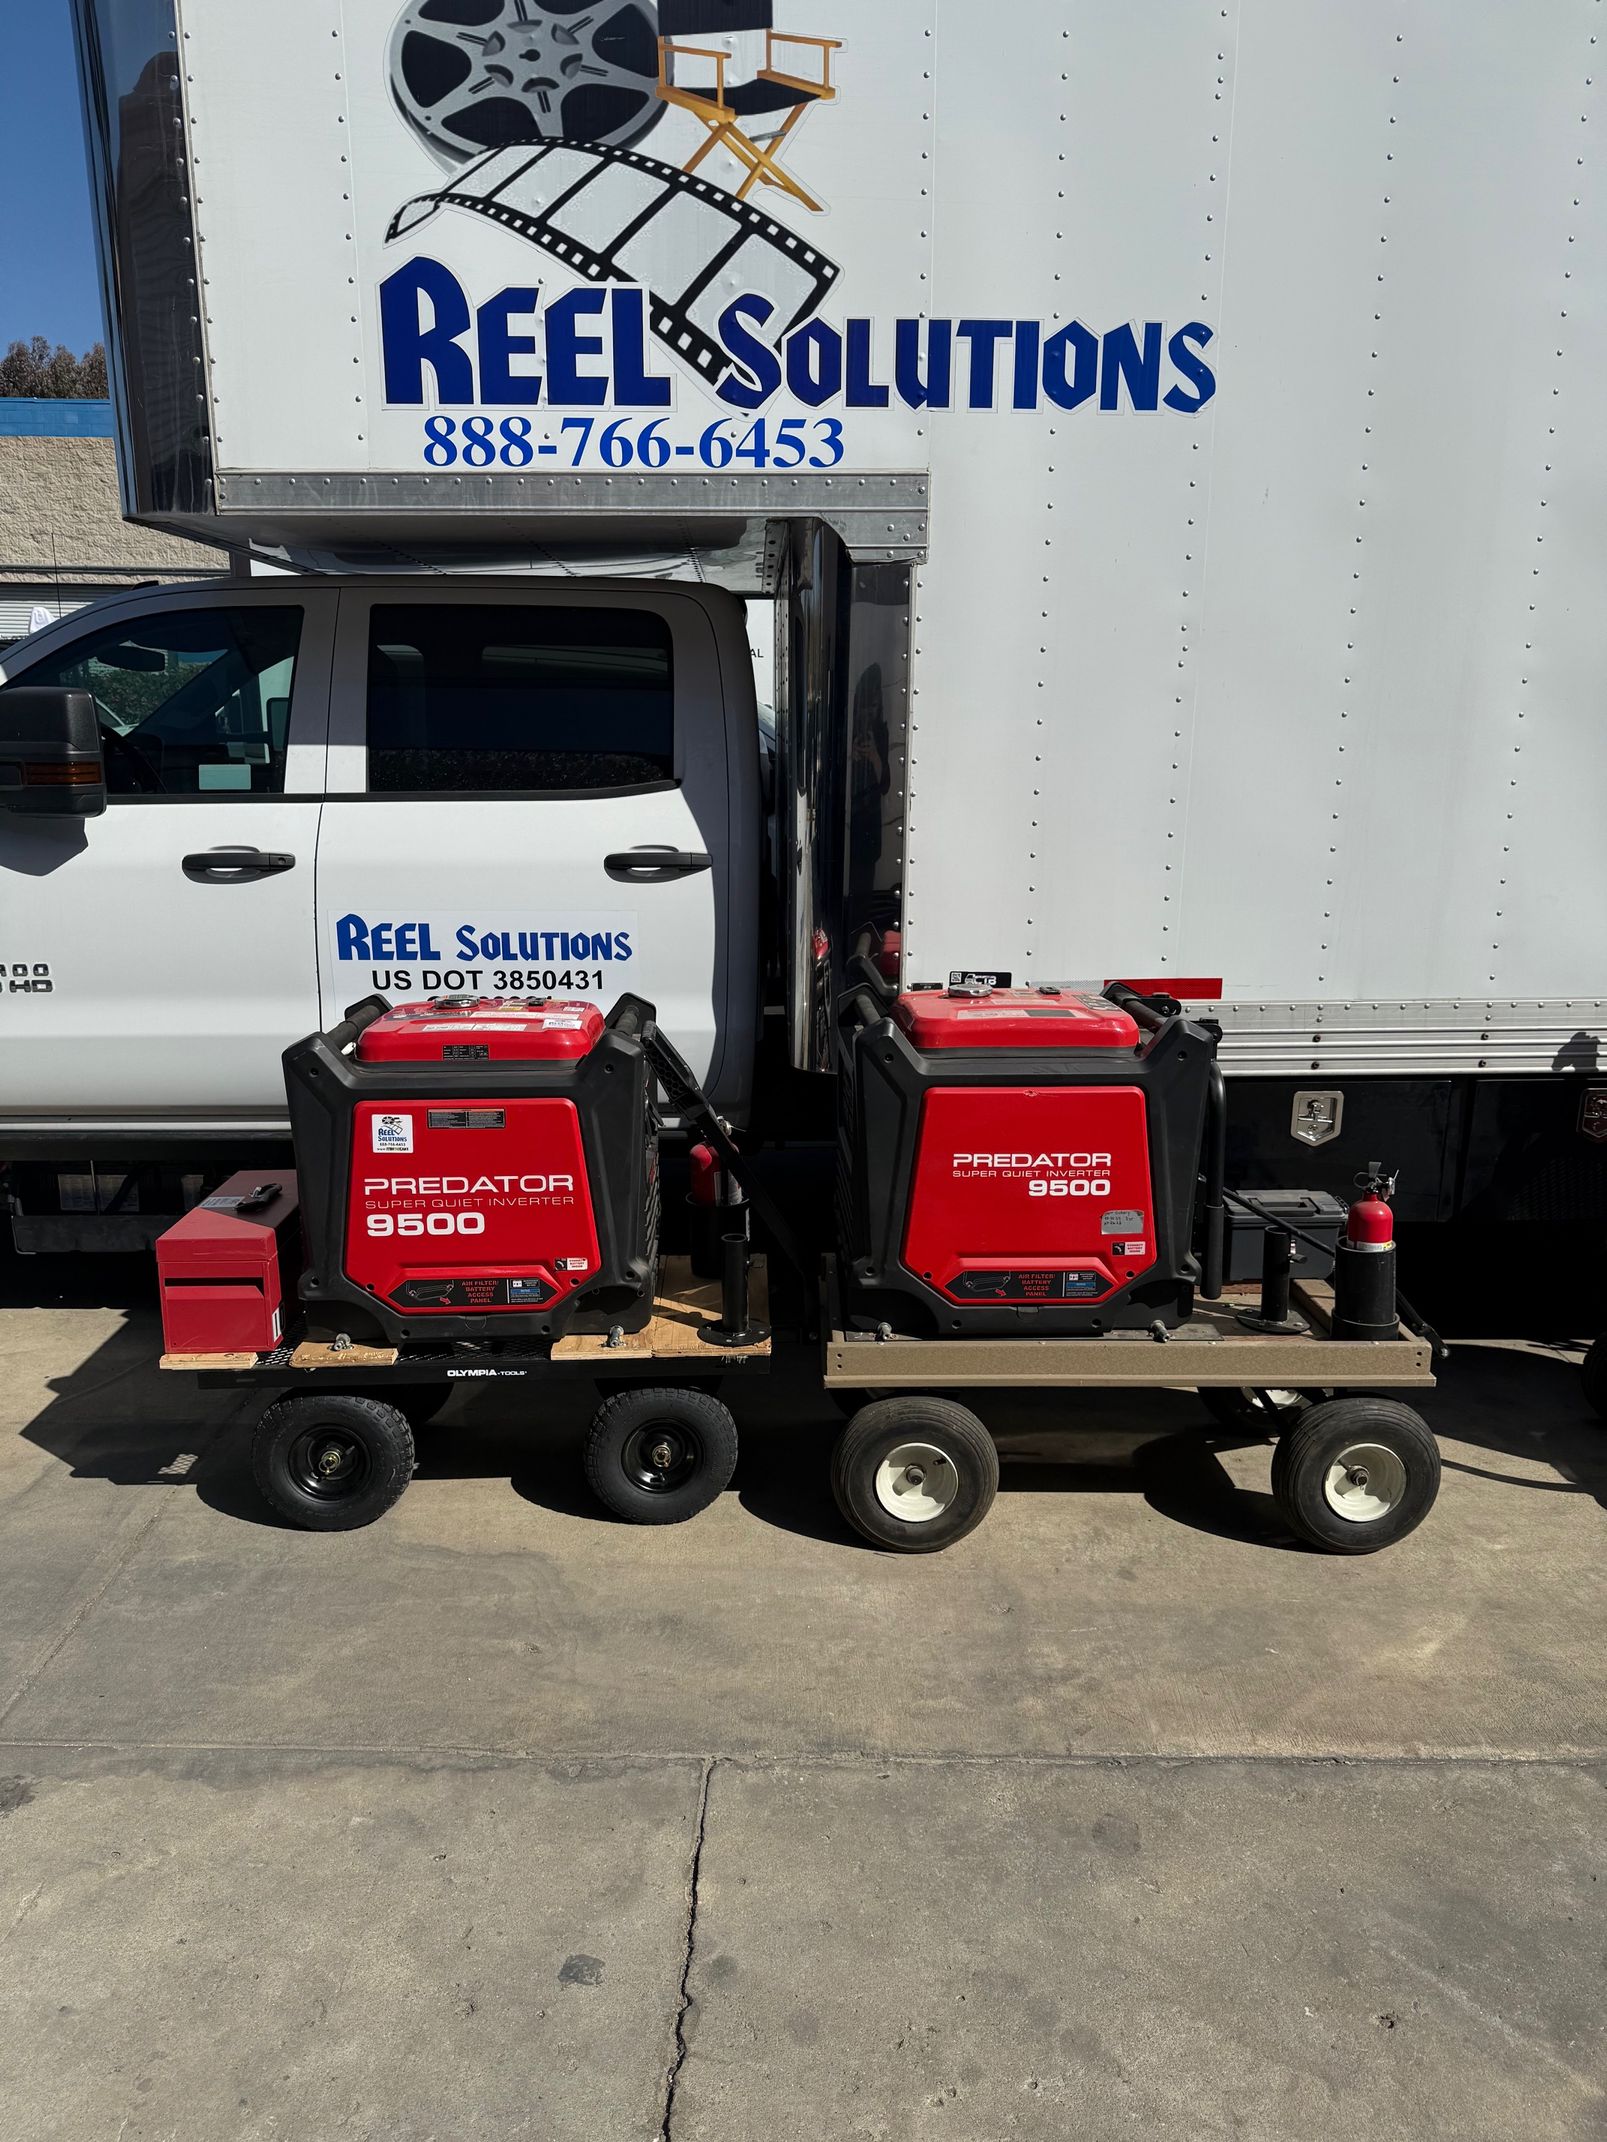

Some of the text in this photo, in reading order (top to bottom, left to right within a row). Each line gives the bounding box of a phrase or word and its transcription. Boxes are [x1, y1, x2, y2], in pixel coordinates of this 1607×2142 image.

[381, 256, 1217, 412] REEL SOLUTIONS
[424, 416, 844, 469] 888-766-6453
[336, 913, 633, 962] REEL SOLUTIONS
[372, 970, 603, 990] US DOT 3850431
[953, 1153, 1112, 1168] PREDATOR
[952, 1169, 1111, 1178] SUPER QUIET INVERTER
[364, 1174, 574, 1196] PREDATOR
[1028, 1179, 1111, 1197] 9500
[365, 1196, 574, 1210] SUPER QUIET INVERTER
[366, 1212, 485, 1237] 9500
[446, 1369, 498, 1377] OLYMPIA
